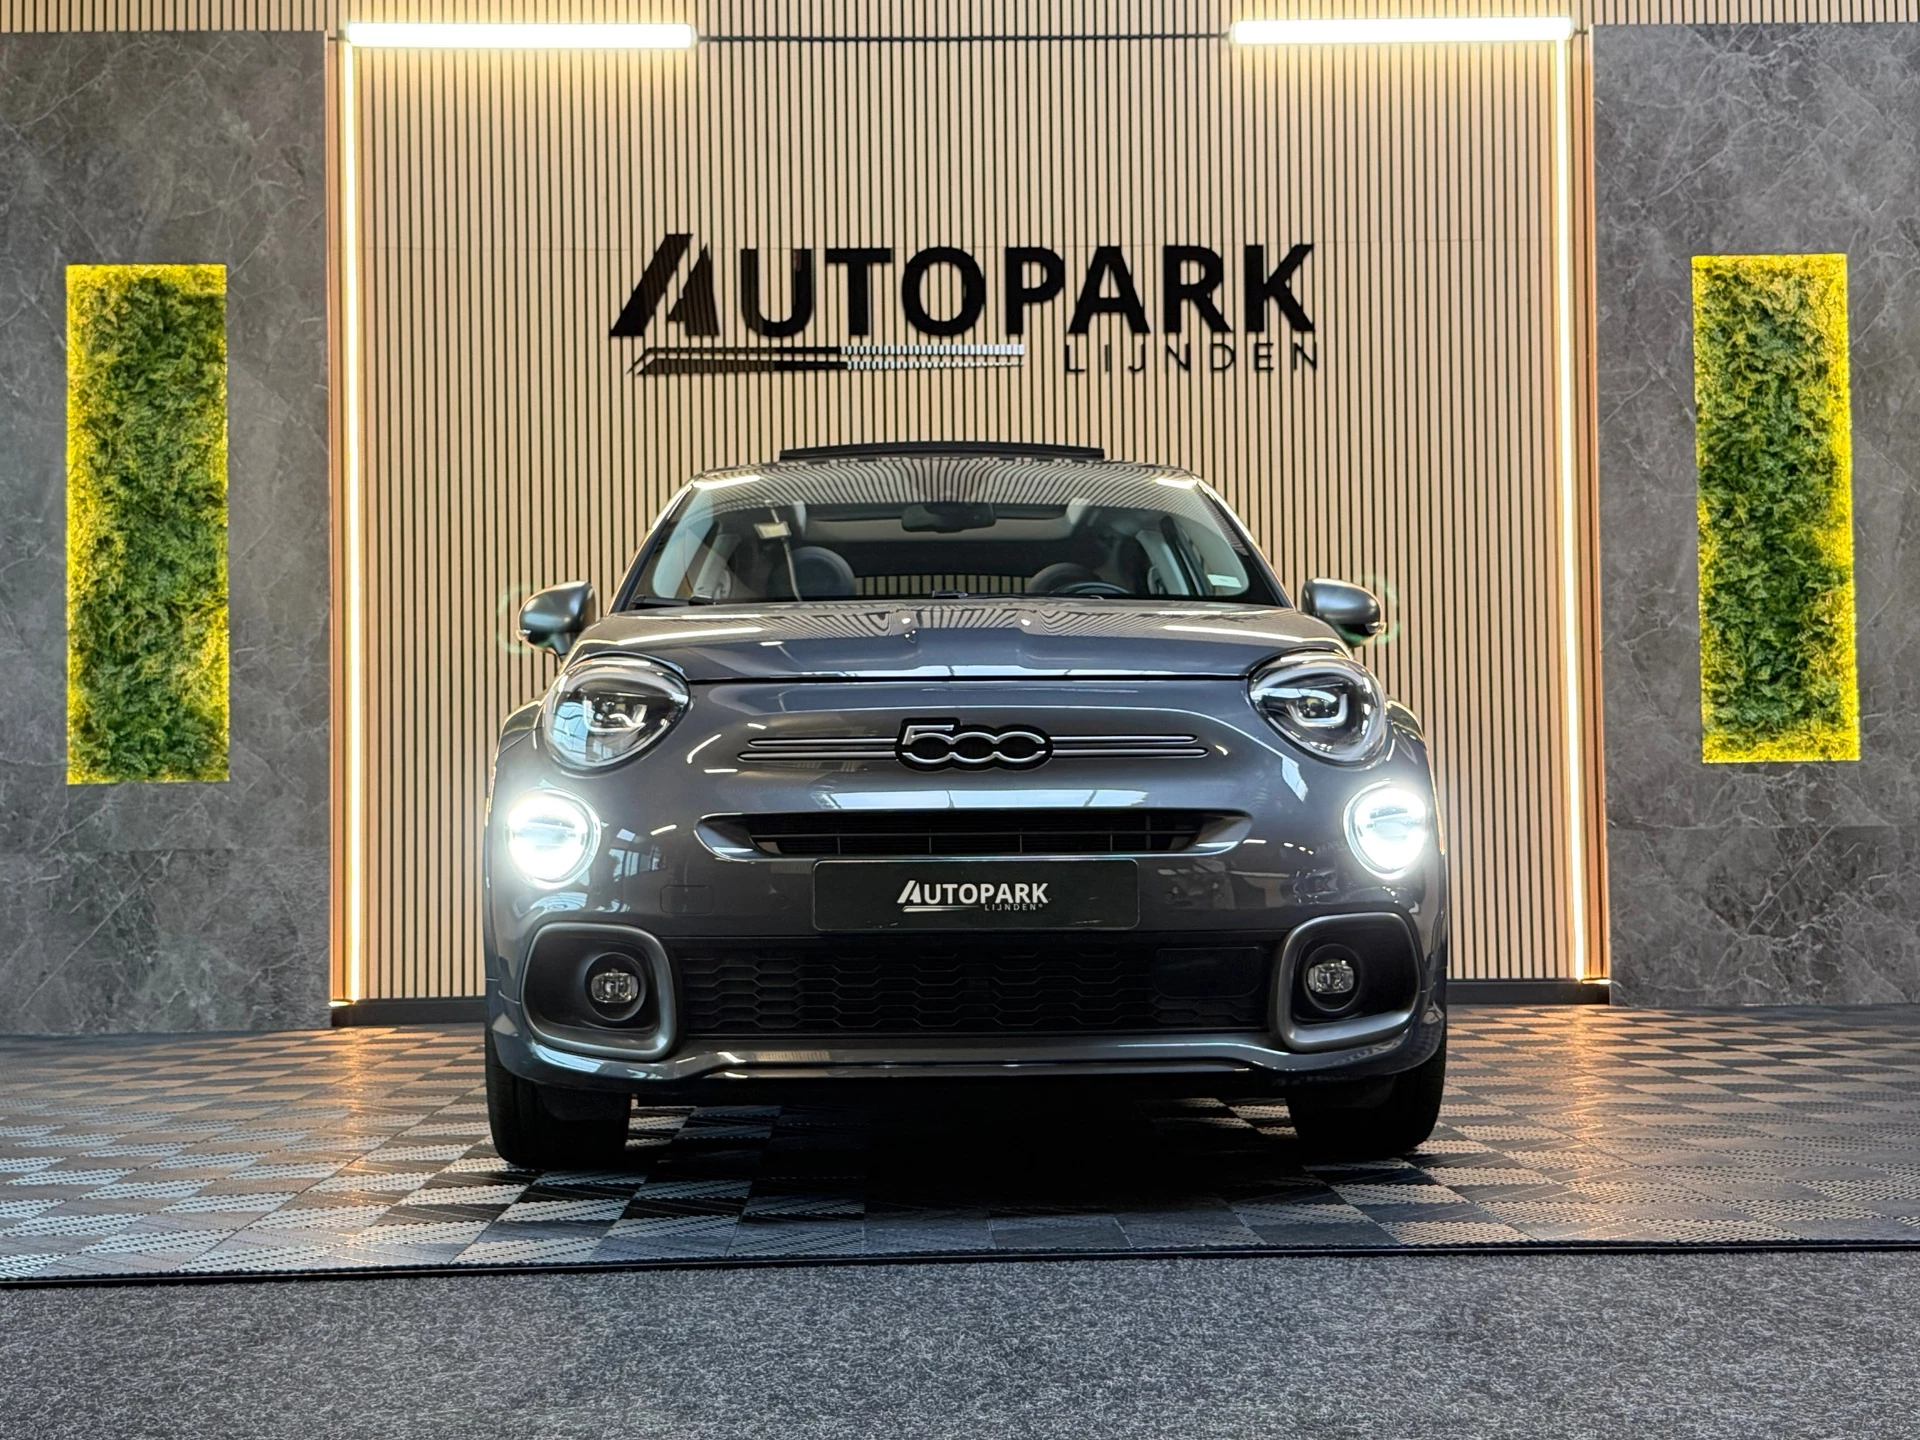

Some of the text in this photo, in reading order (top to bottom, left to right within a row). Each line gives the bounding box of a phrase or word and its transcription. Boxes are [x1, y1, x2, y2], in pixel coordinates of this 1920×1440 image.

[608, 233, 1316, 338] AUTOPARK
[1064, 341, 1318, 373] LIJNDEN
[901, 723, 1047, 765] 500
[897, 879, 1049, 904] AUTOPARK
